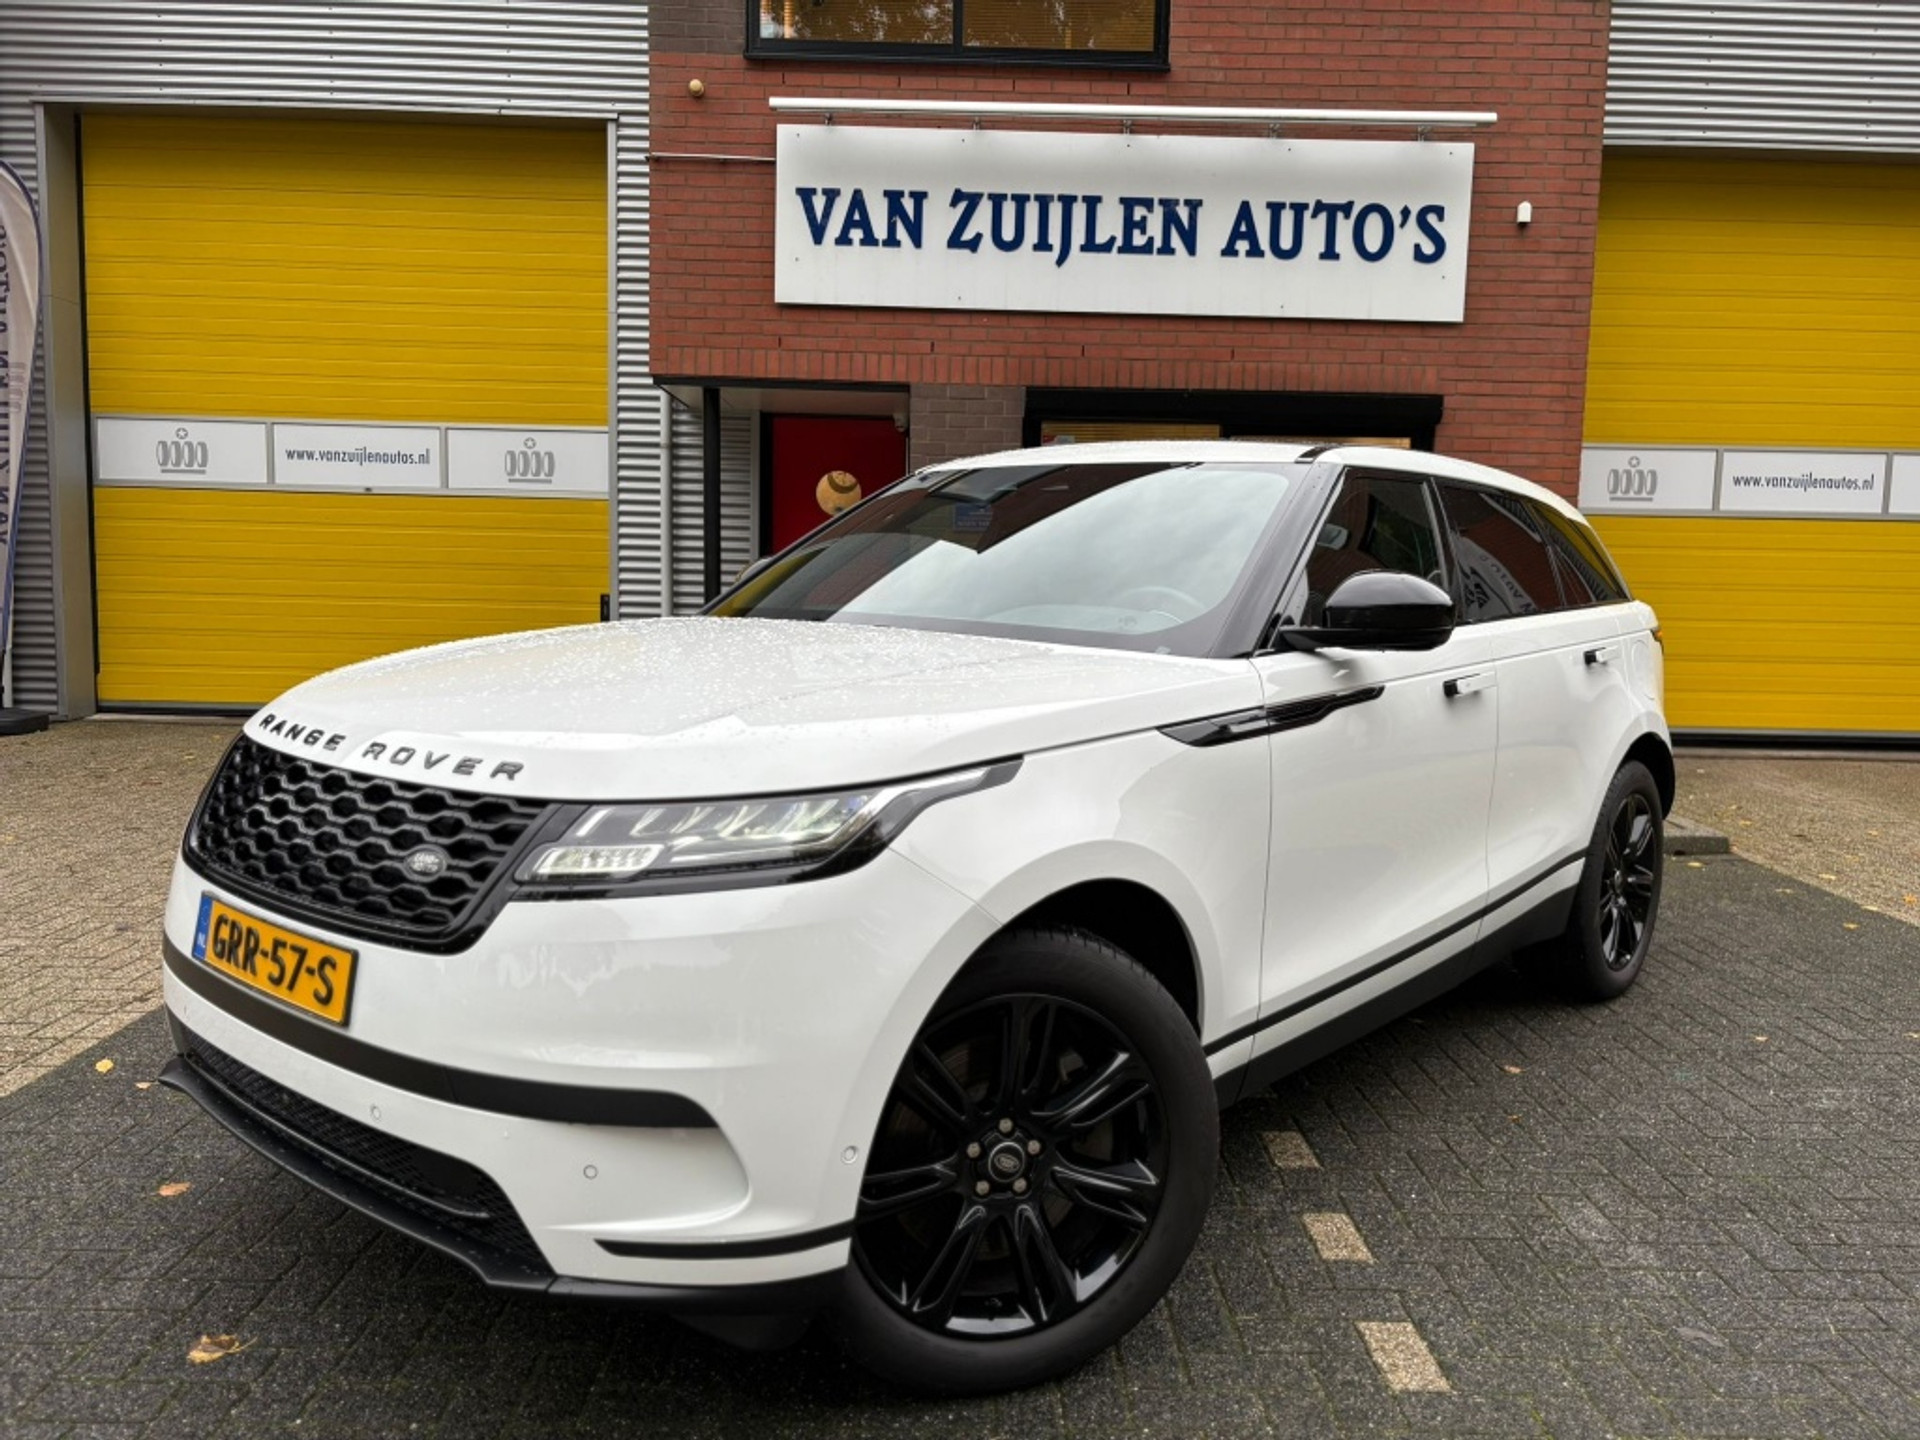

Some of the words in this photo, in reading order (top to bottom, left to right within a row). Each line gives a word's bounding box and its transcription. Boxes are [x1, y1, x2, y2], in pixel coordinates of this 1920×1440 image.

[795, 187, 928, 249] VAN
[946, 188, 1203, 268] ZUIJLEN
[1220, 199, 1447, 264] AUTO'S
[285, 446, 431, 466] www.vanzuijlenautos.nl
[1732, 472, 1875, 492] www.vanzuijlenautos.nl
[258, 713, 347, 751] RANGE
[361, 741, 525, 781] ROVER
[212, 913, 337, 1006] GRR-57-S
